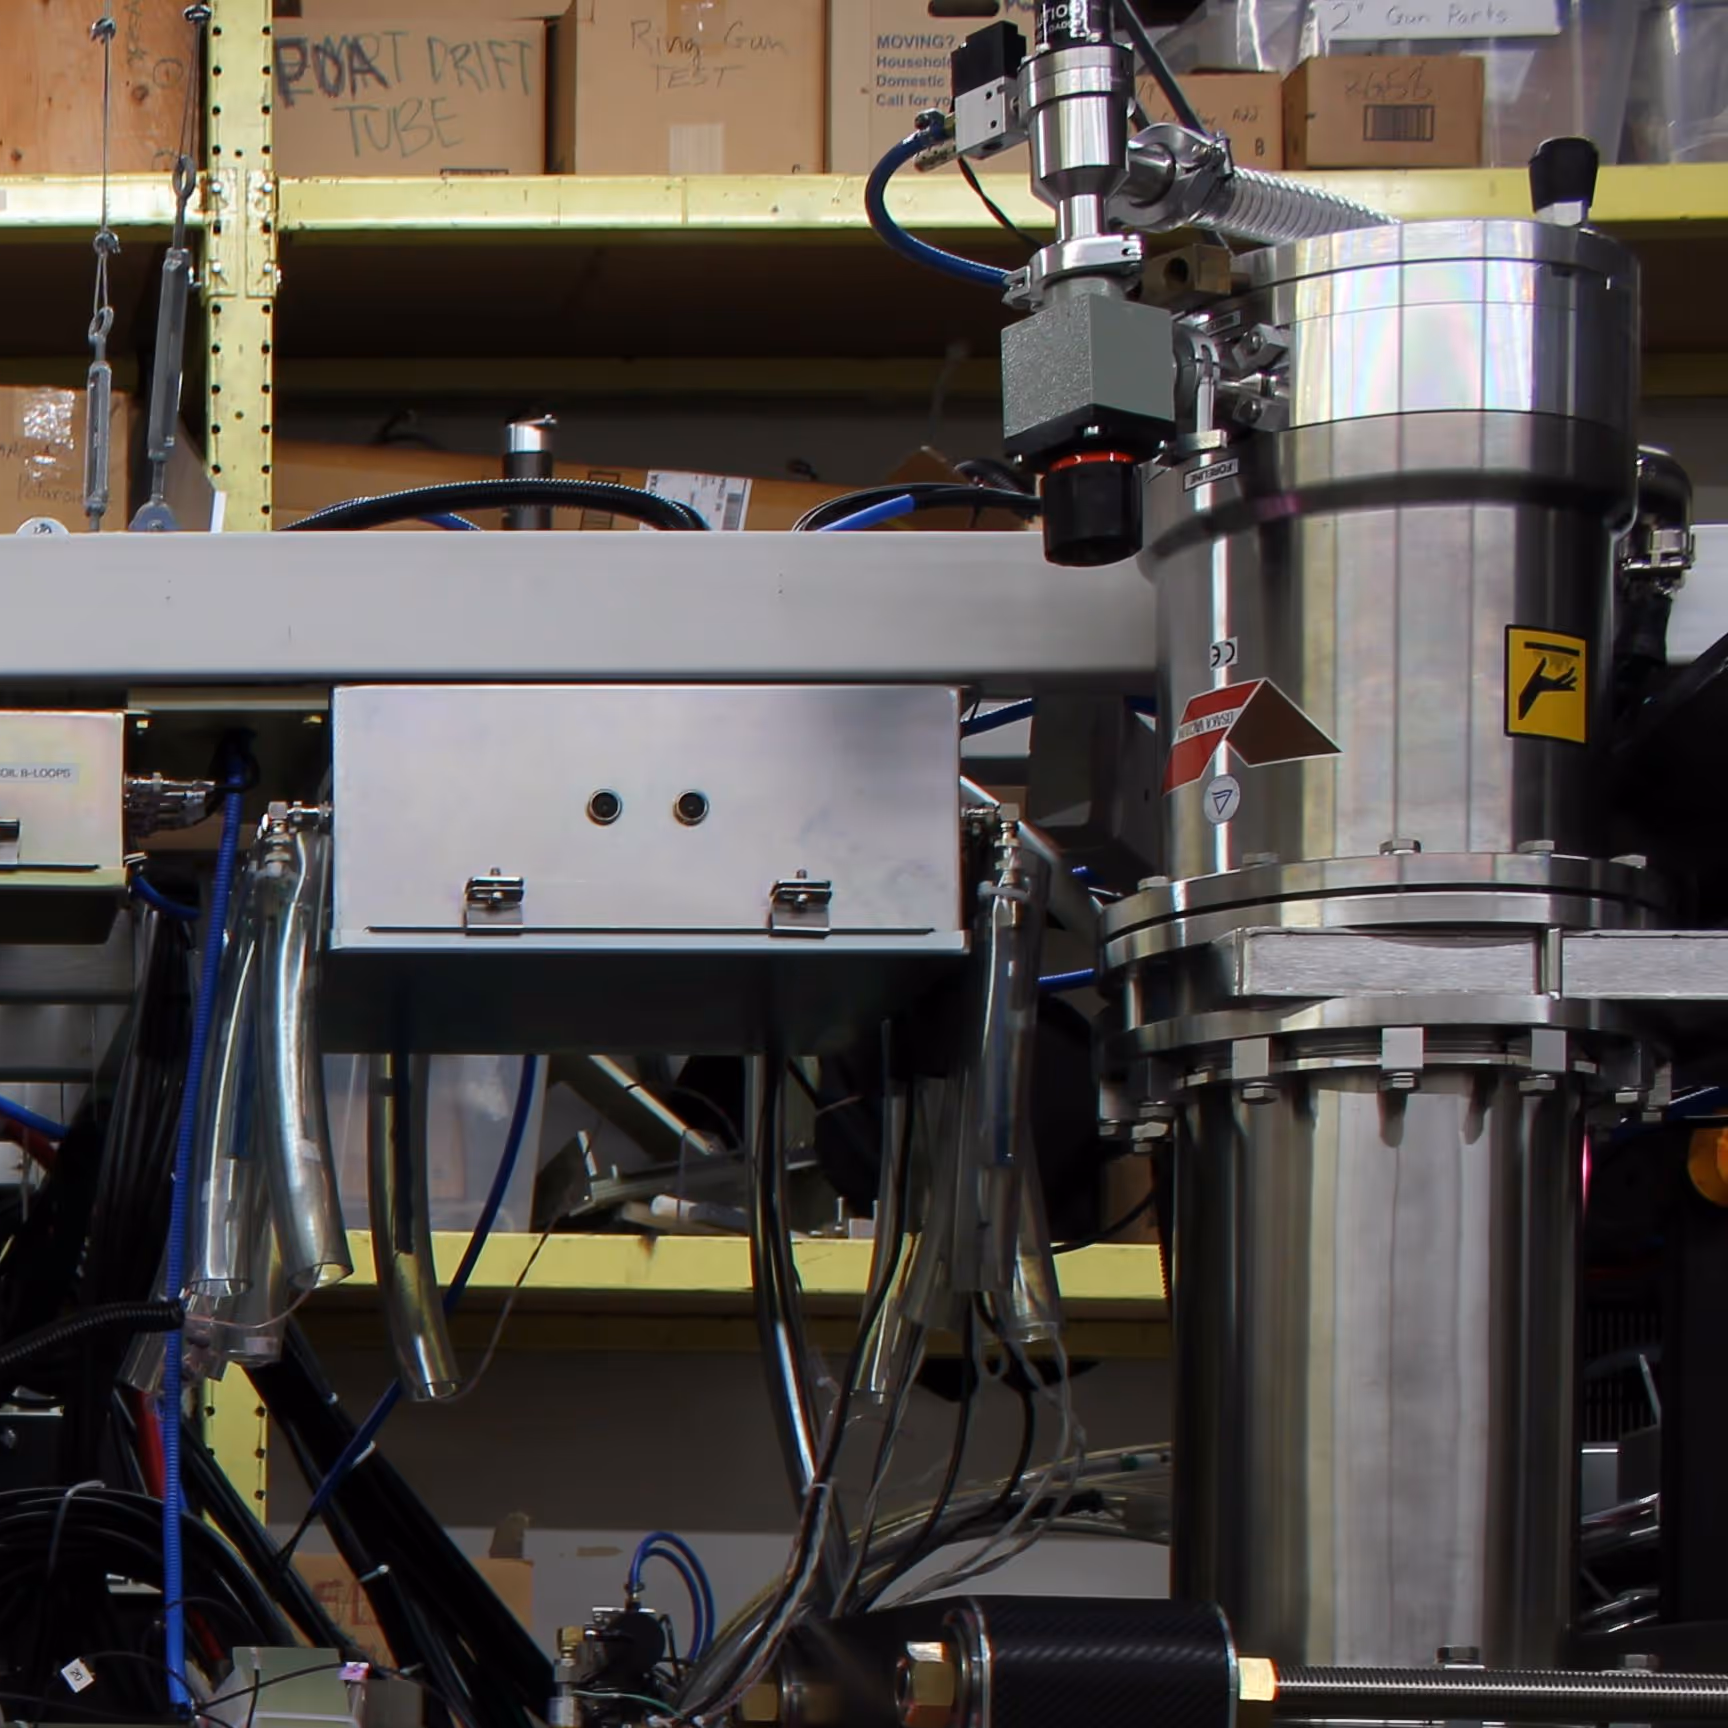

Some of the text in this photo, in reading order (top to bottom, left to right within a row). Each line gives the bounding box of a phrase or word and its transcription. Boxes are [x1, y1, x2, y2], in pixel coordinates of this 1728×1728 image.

[1386, 7, 1431, 26] Gun
[1448, 4, 1508, 24] Parts
[630, 19, 788, 71] Ring Gun
[877, 34, 956, 49] MOVING?
[428, 36, 533, 96] DRIFT
[651, 64, 746, 92] TEST
[876, 75, 944, 88] Domestic
[876, 94, 905, 107] Call
[910, 94, 928, 107] for
[332, 97, 464, 158] TUBE
[1255, 138, 1265, 156] B
